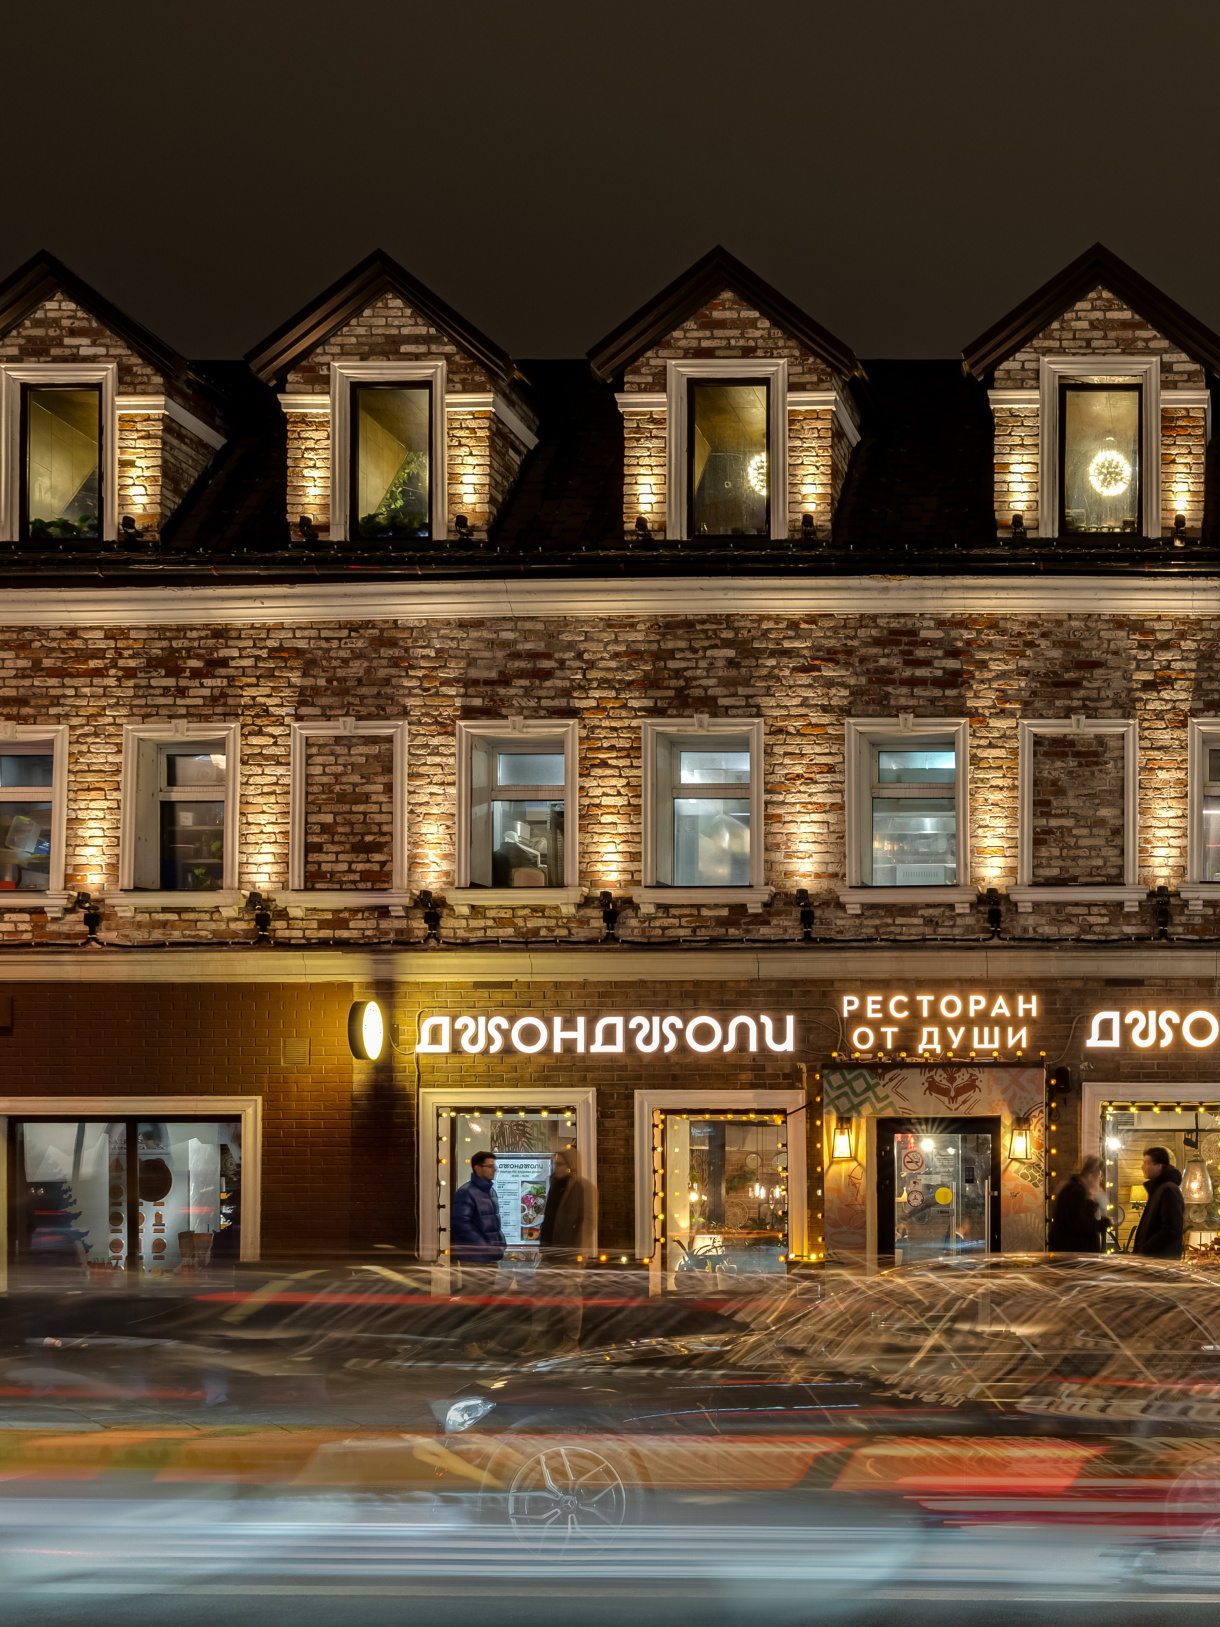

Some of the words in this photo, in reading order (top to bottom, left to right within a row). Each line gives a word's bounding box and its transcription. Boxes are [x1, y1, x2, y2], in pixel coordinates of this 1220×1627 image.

[842, 994, 1038, 1018] РЕСТОРАН
[852, 1026, 899, 1050] ОТ
[917, 1025, 1028, 1054] ДУШИ
